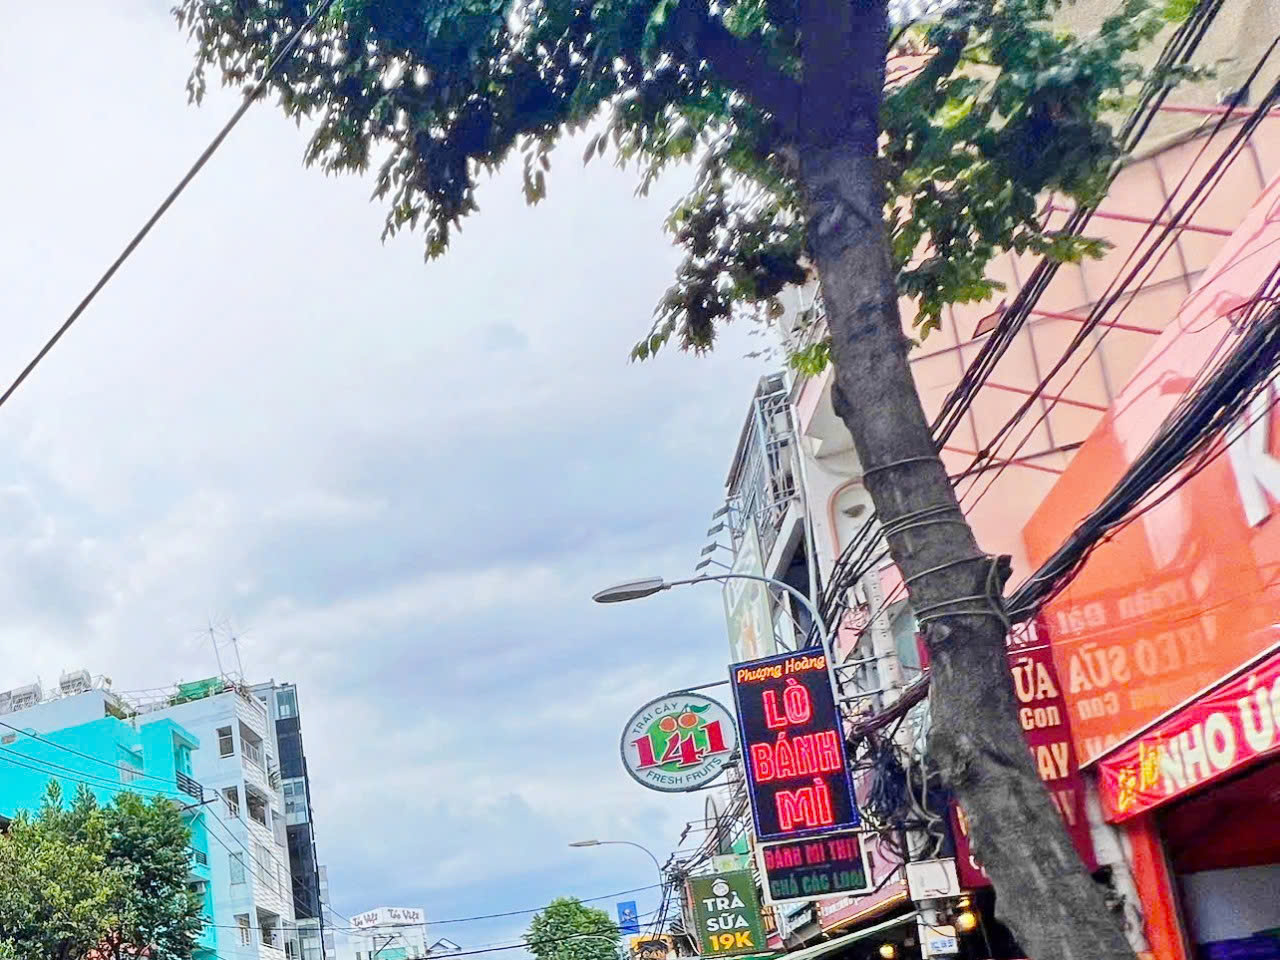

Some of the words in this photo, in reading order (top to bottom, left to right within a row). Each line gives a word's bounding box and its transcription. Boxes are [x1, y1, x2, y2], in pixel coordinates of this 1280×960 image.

[737, 663, 782, 684] Phượng
[785, 655, 825, 675] Hoàng
[1011, 656, 1059, 703] ỮA
[762, 677, 811, 729] LÒ
[631, 720, 731, 771] 141
[751, 730, 841, 782] BÁNH
[1159, 712, 1235, 795] NHO
[1238, 675, 1280, 752] Ú
[646, 770, 683, 785] FRESH
[686, 757, 722, 783] FRUITS
[775, 777, 833, 831] MÌ
[703, 891, 746, 911] TRÀ
[707, 912, 750, 932] SỮA
[709, 930, 754, 951] 19K
